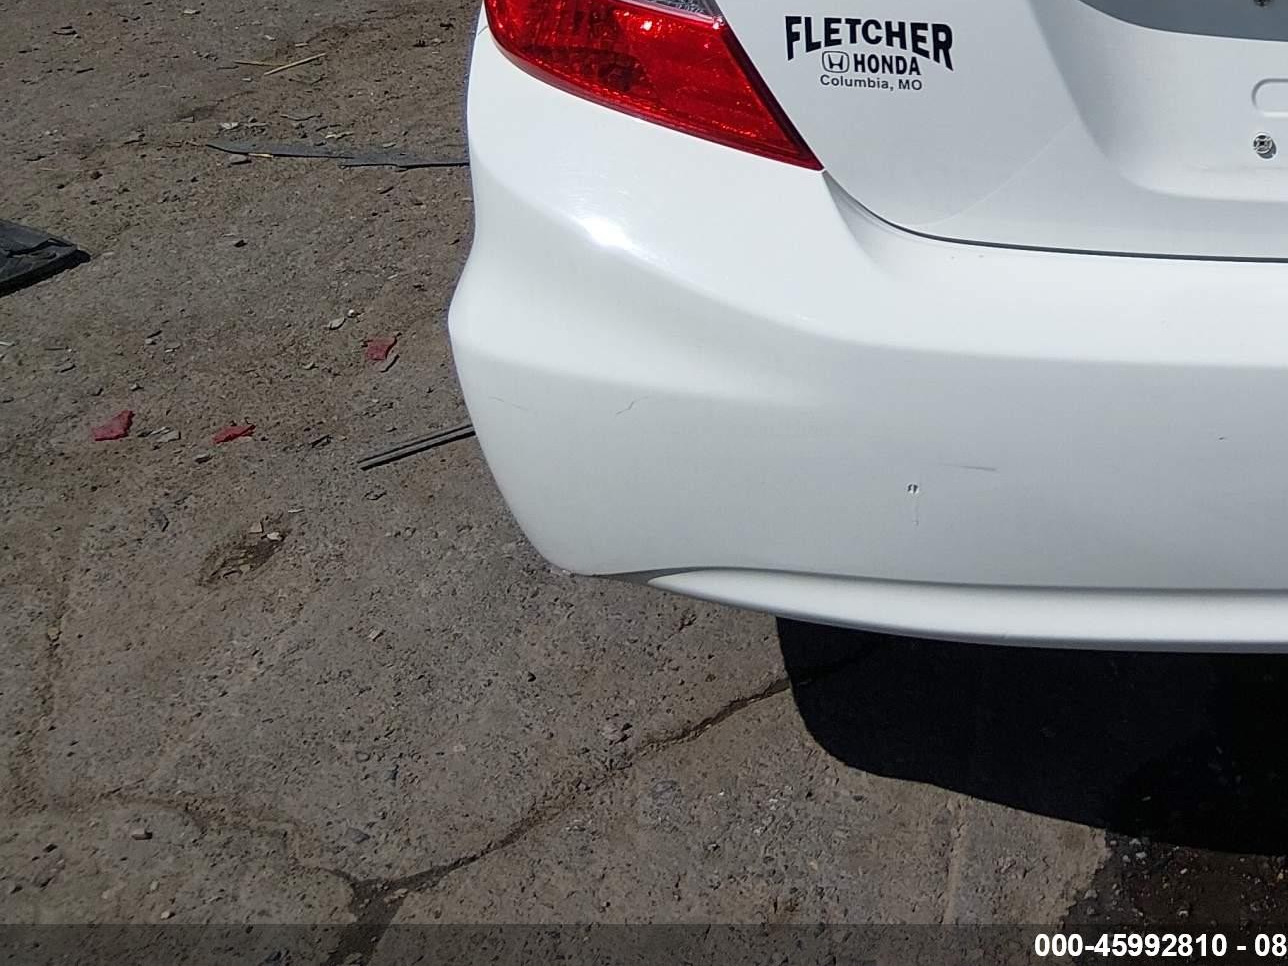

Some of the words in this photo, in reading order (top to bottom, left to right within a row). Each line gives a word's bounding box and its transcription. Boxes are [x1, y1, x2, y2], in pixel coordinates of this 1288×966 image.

[784, 15, 954, 72] FLETCHER
[853, 53, 922, 76] HONDA
[819, 74, 894, 92] Columbia,
[898, 78, 923, 91] MO
